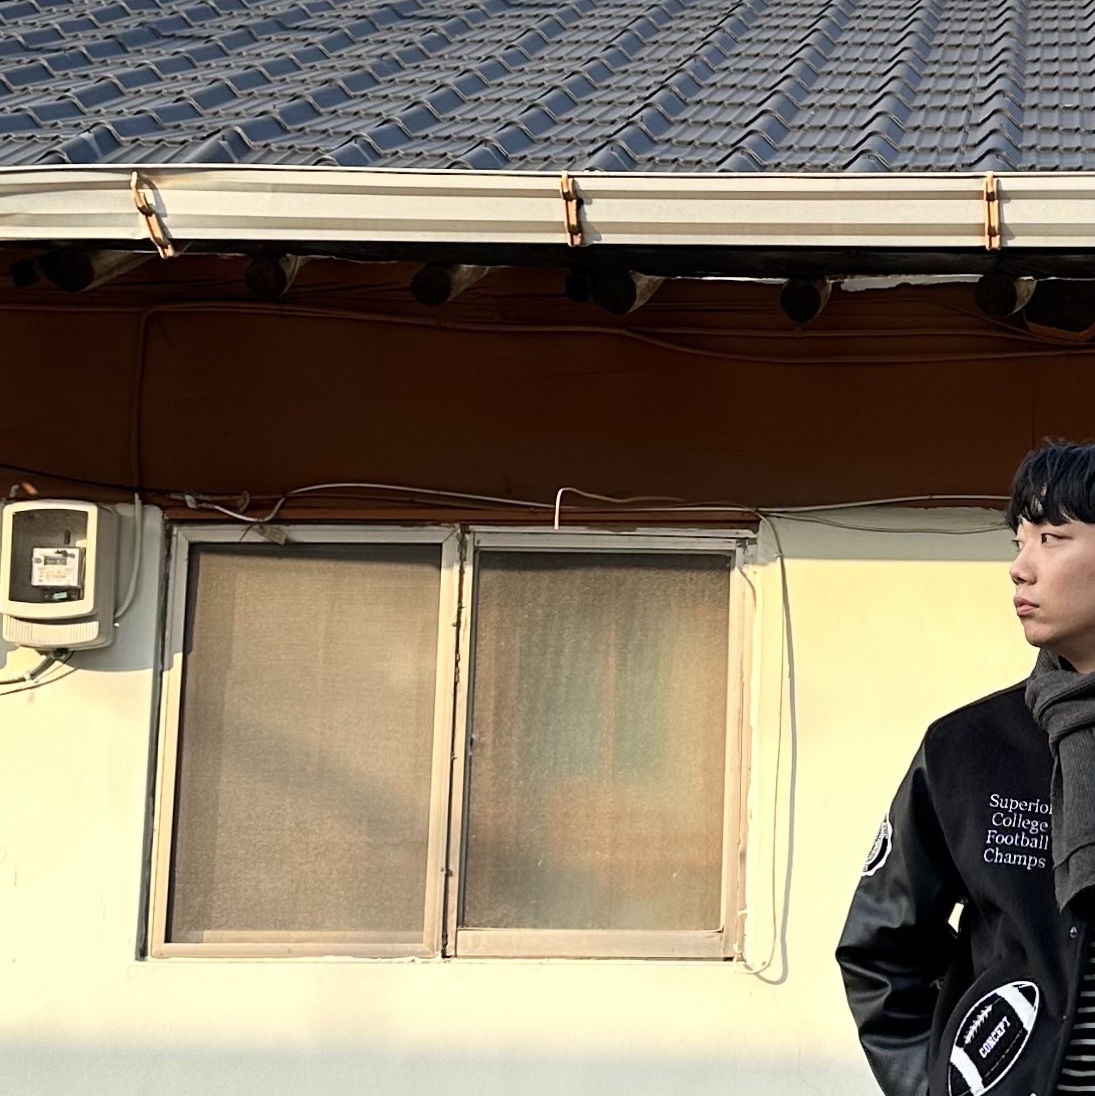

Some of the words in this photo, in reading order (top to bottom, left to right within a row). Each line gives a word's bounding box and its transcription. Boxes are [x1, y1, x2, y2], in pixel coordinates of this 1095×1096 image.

[991, 812, 1049, 834] College
[985, 829, 1049, 850] Football
[983, 847, 1047, 870] Champs
